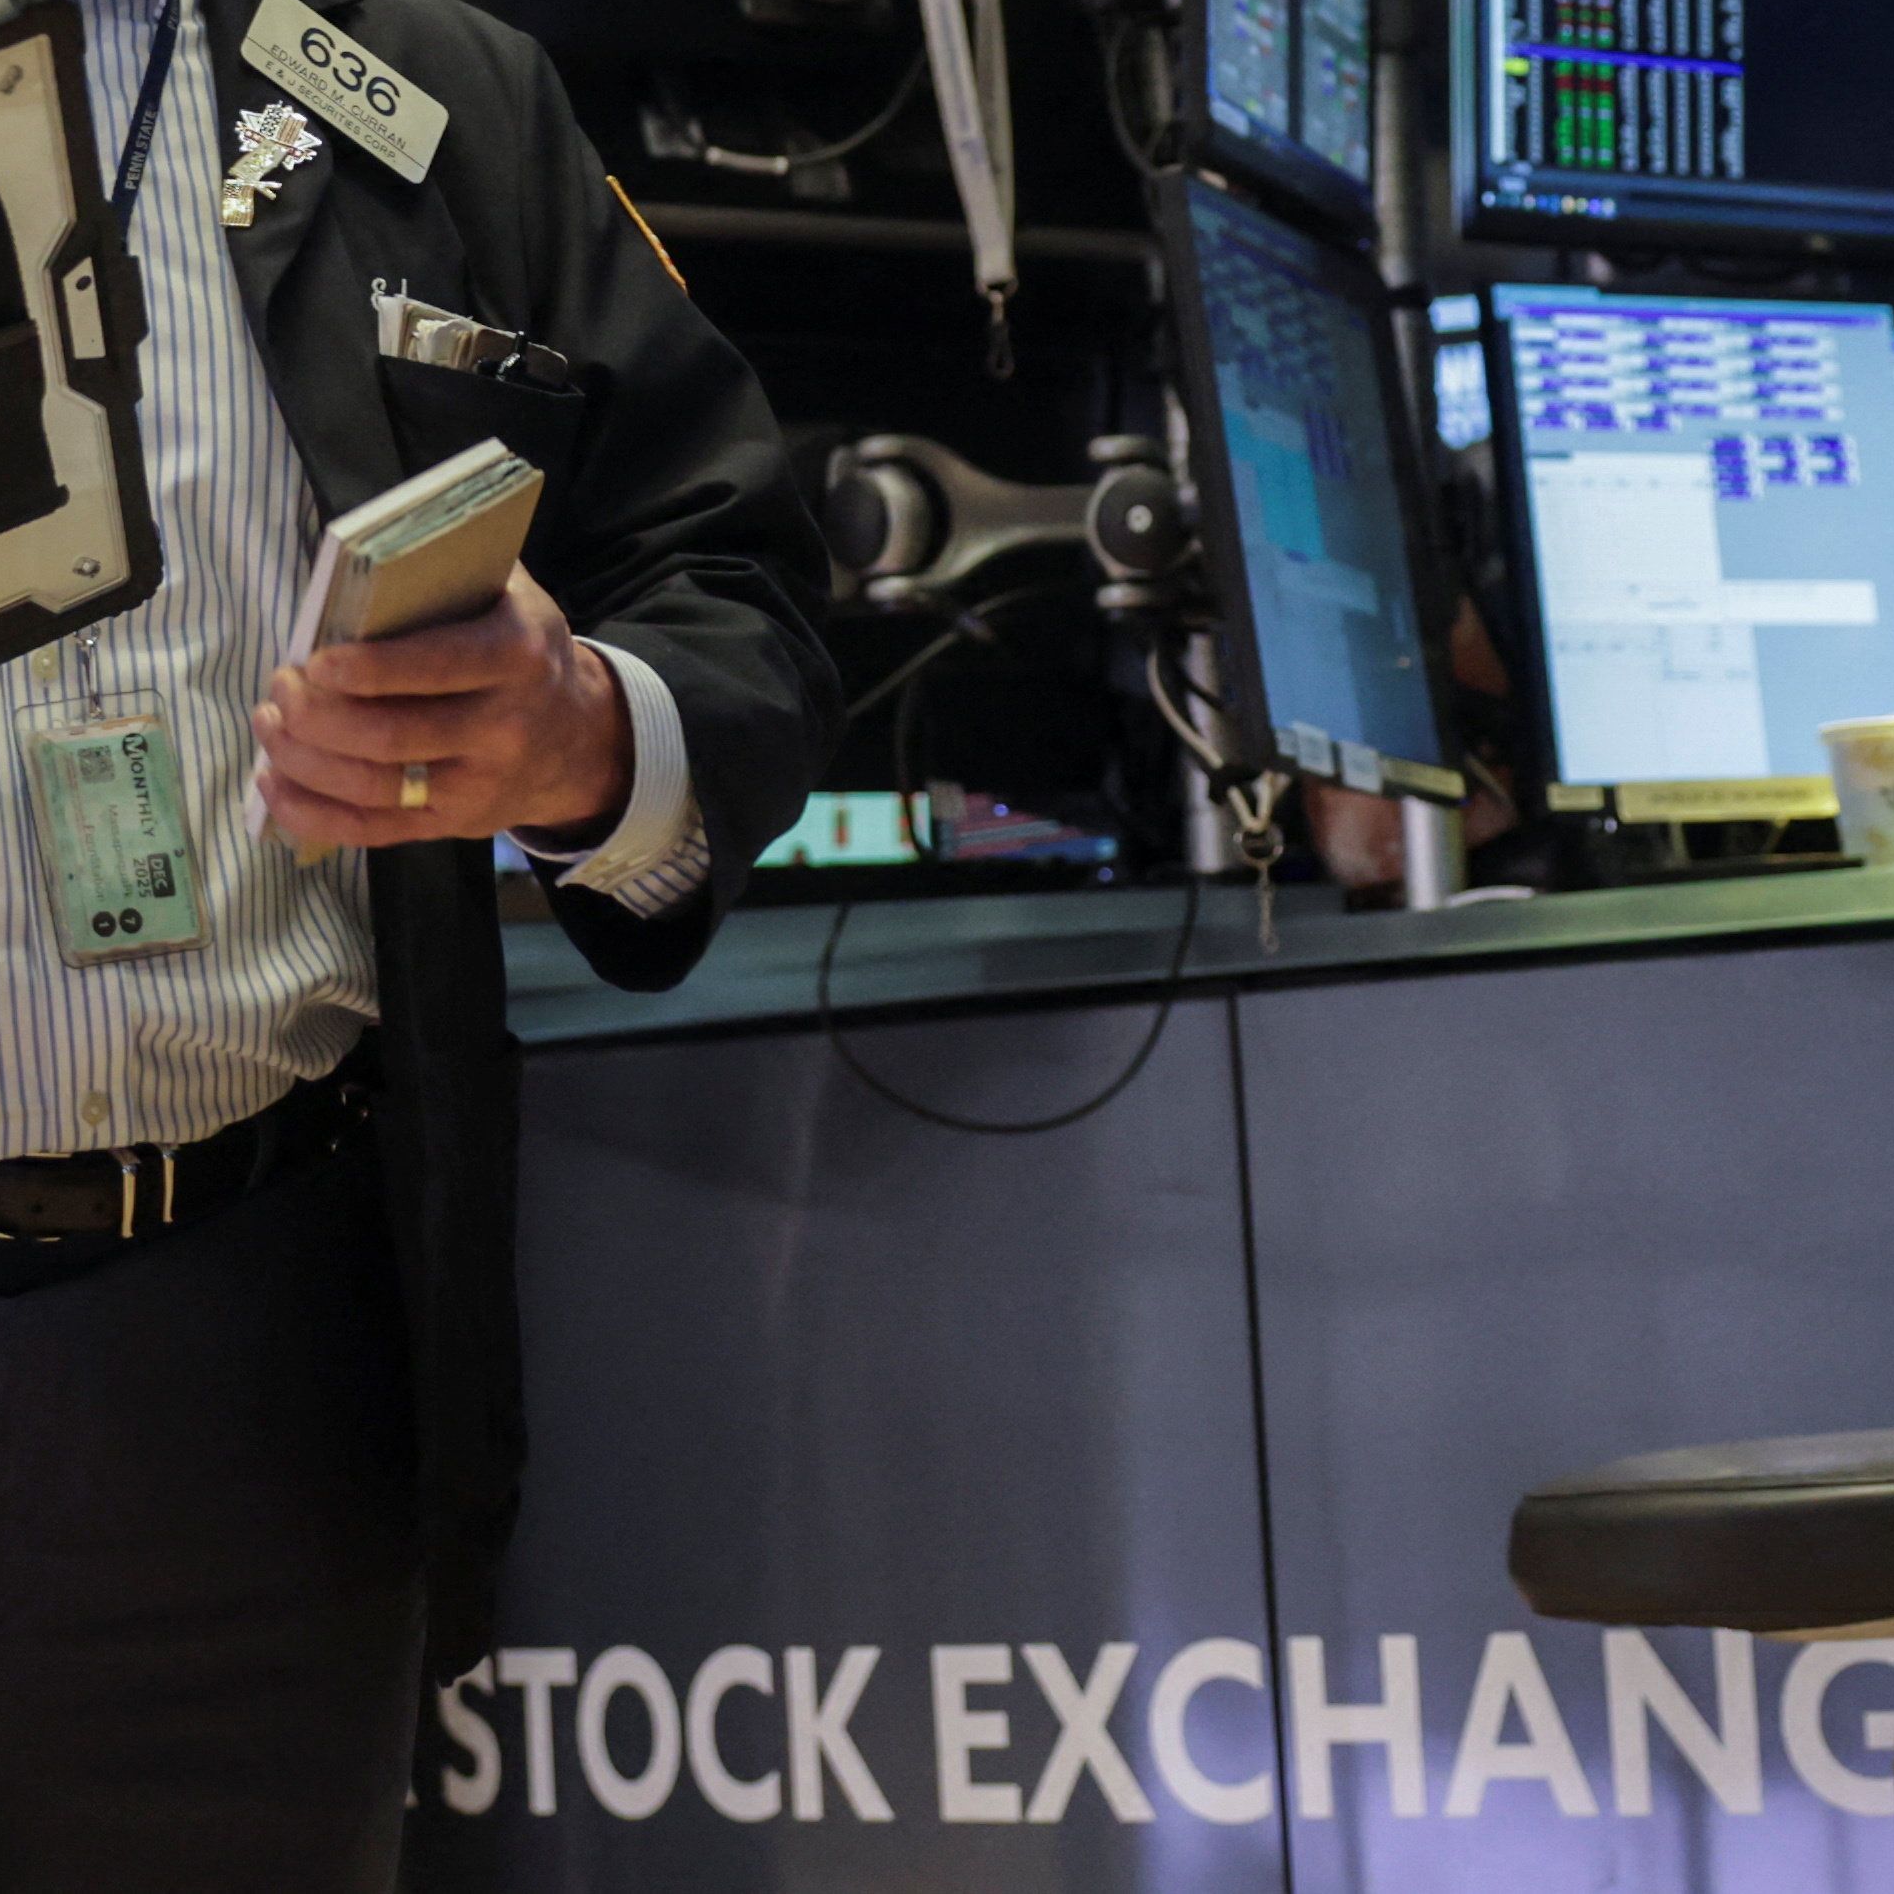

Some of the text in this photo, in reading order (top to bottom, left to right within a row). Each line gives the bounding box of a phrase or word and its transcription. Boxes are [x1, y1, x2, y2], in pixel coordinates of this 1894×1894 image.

[265, 60, 274, 70] E
[275, 68, 284, 79] &
[296, 85, 361, 136] SECURITIES
[363, 133, 398, 163] CORP.
[270, 44, 407, 150] EDWARD M. CURRAN
[300, 27, 401, 117] 636
[125, 108, 157, 190] PENN STATE
[122, 732, 155, 838] MONTHLY
[133, 858, 154, 899] 2025
[435, 1644, 896, 1823] STOCK
